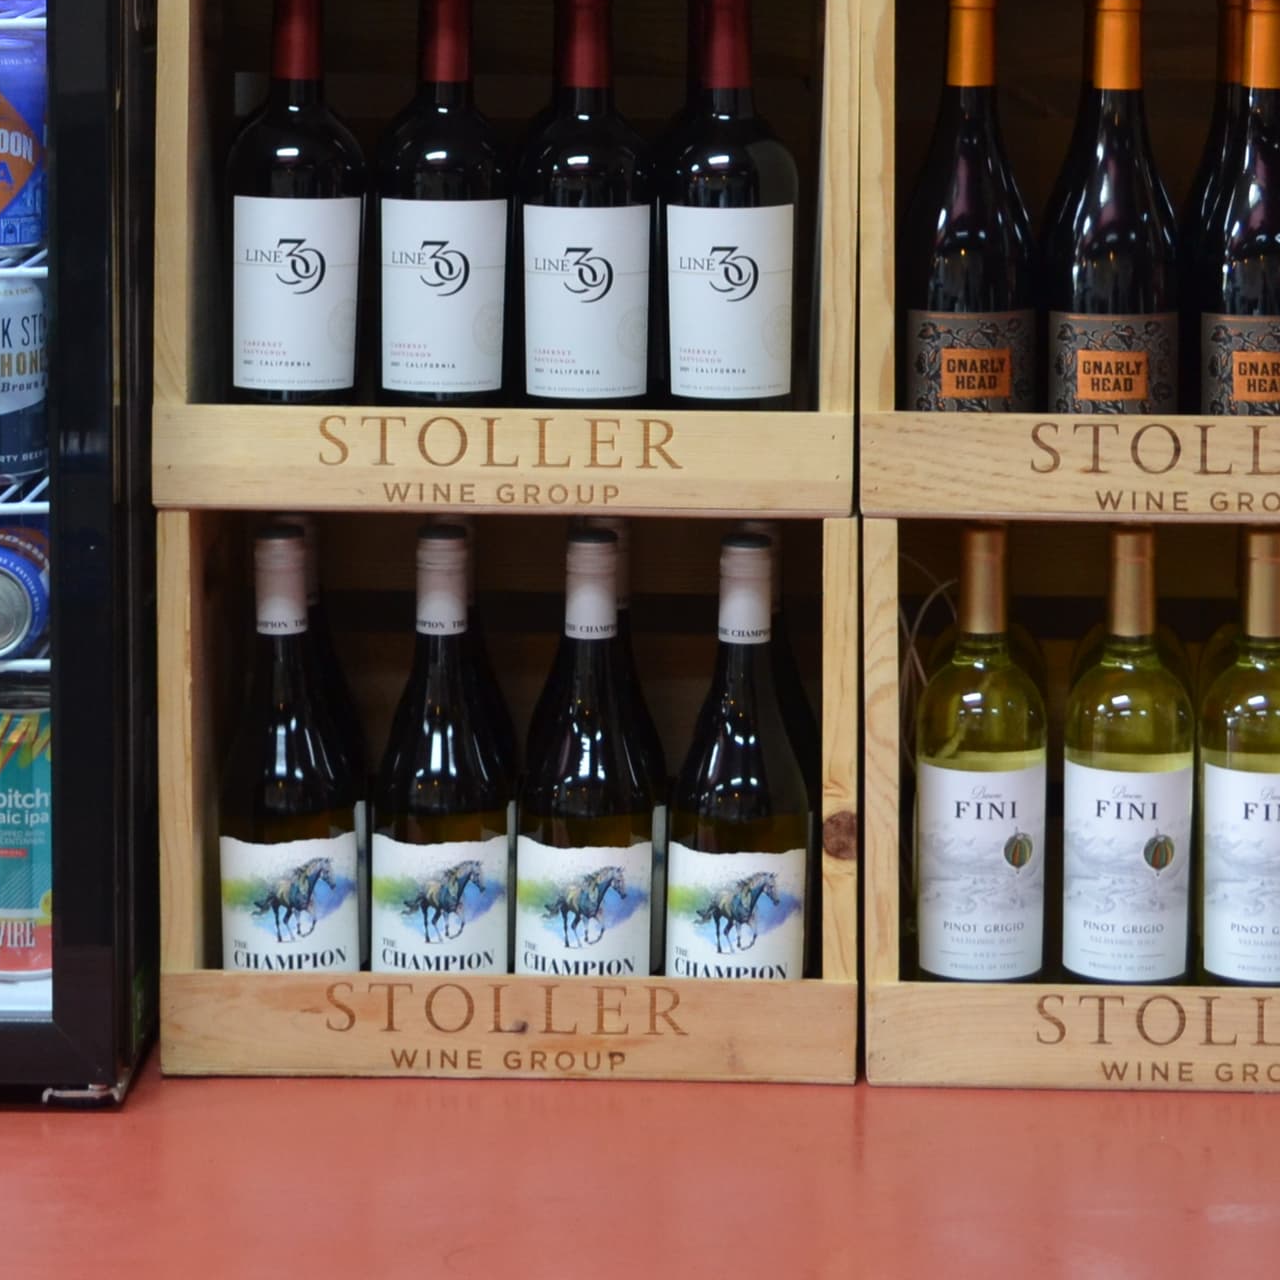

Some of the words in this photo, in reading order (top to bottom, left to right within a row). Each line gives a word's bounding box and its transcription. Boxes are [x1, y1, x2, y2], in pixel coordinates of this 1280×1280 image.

[245, 249, 283, 263] LINE
[276, 238, 326, 294] 39
[534, 257, 570, 272] LINE
[563, 247, 614, 303] 39
[679, 256, 716, 271] LINE
[709, 246, 759, 302] 39
[1083, 360, 1142, 376] GNARLY
[1091, 377, 1133, 392] HEAD
[318, 415, 683, 470] STOLLER
[383, 482, 476, 504] WINE
[497, 483, 620, 505] GROUP
[1095, 490, 1189, 511] WINE
[24, 811, 49, 826] ipa
[954, 800, 1018, 820] FINI
[1096, 799, 1159, 820] FINI
[944, 921, 977, 932] PINOT
[984, 922, 1024, 933] GRIGIO
[1231, 923, 1266, 935] PINOT
[234, 947, 347, 970] CHAMPION
[382, 949, 494, 971] CHAMPION
[325, 981, 689, 1036] STOLLER
[390, 1048, 483, 1070] WINE
[503, 1049, 627, 1071] GROUP
[1100, 1060, 1194, 1082] WINE
